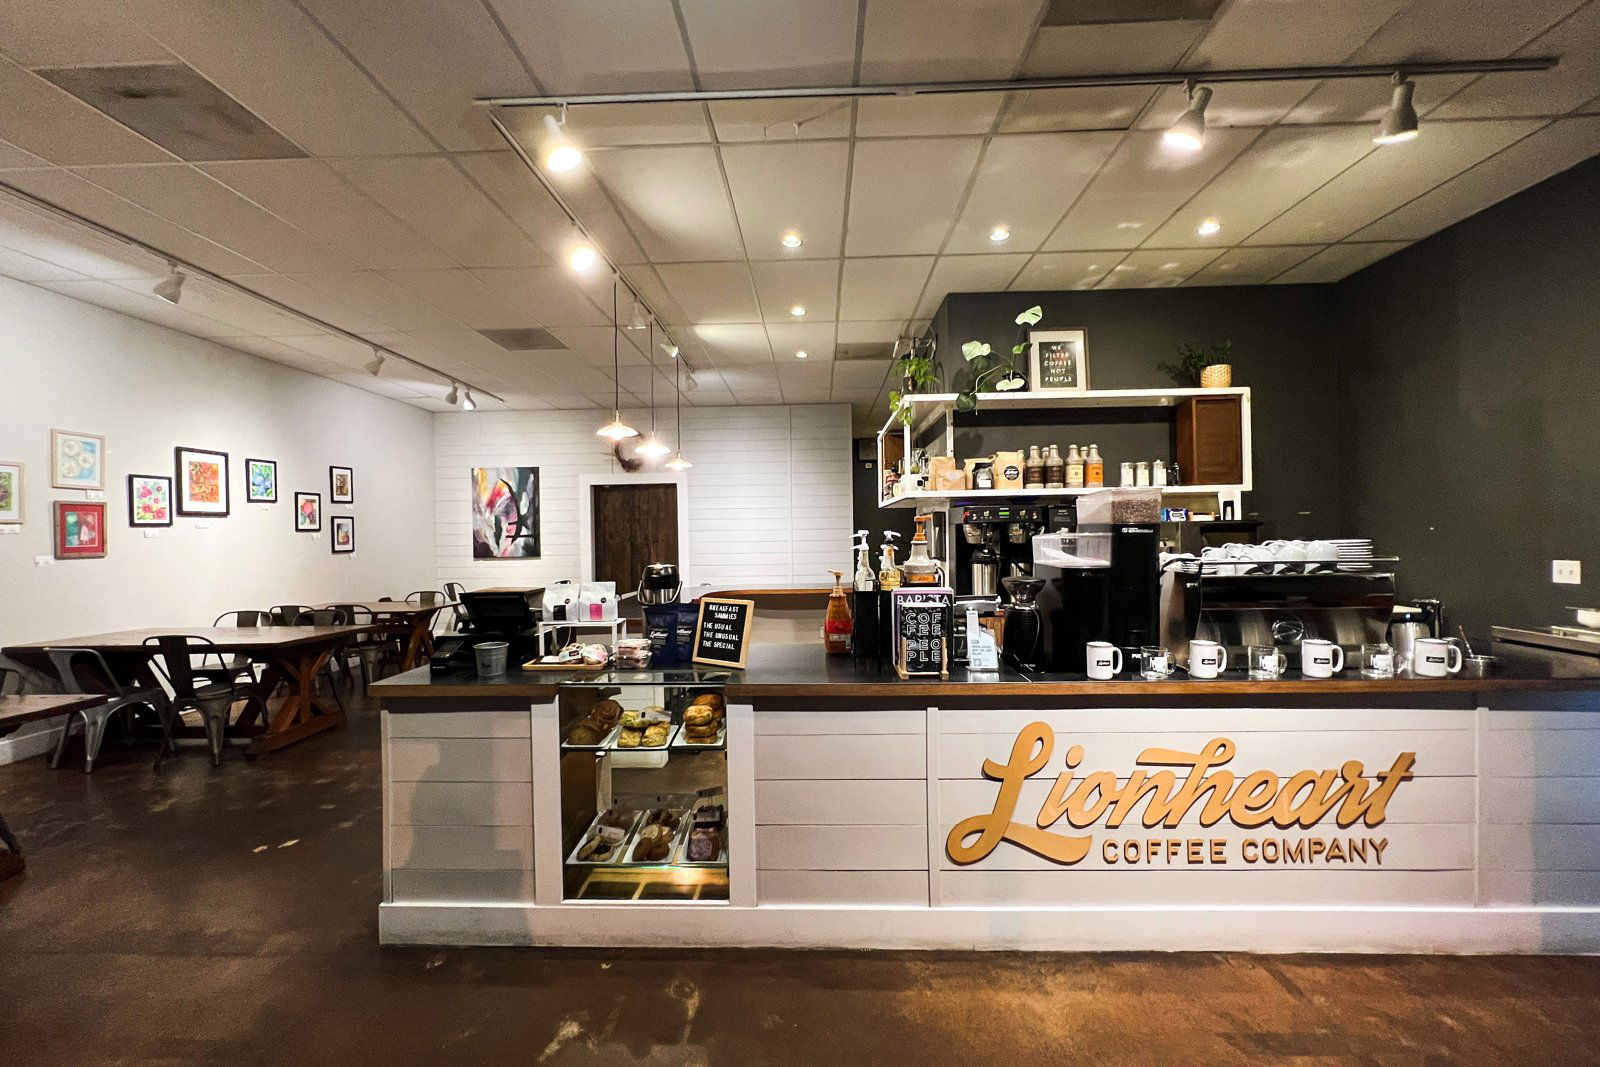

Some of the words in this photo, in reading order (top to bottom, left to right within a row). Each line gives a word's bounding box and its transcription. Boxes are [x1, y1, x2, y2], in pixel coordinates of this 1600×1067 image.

[709, 604, 739, 612] BREAKFAST
[714, 612, 737, 620] SAMMIES
[905, 613, 942, 624] COF
[906, 624, 942, 635] FEE
[715, 633, 739, 641] UNUSUAL
[713, 641, 735, 649] SPECIAL
[906, 639, 942, 650] PEO
[906, 651, 942, 662] PLE
[946, 721, 1416, 864] Lionheart
[1102, 837, 1228, 864] COFFEE
[1241, 837, 1388, 865] COMPANY
